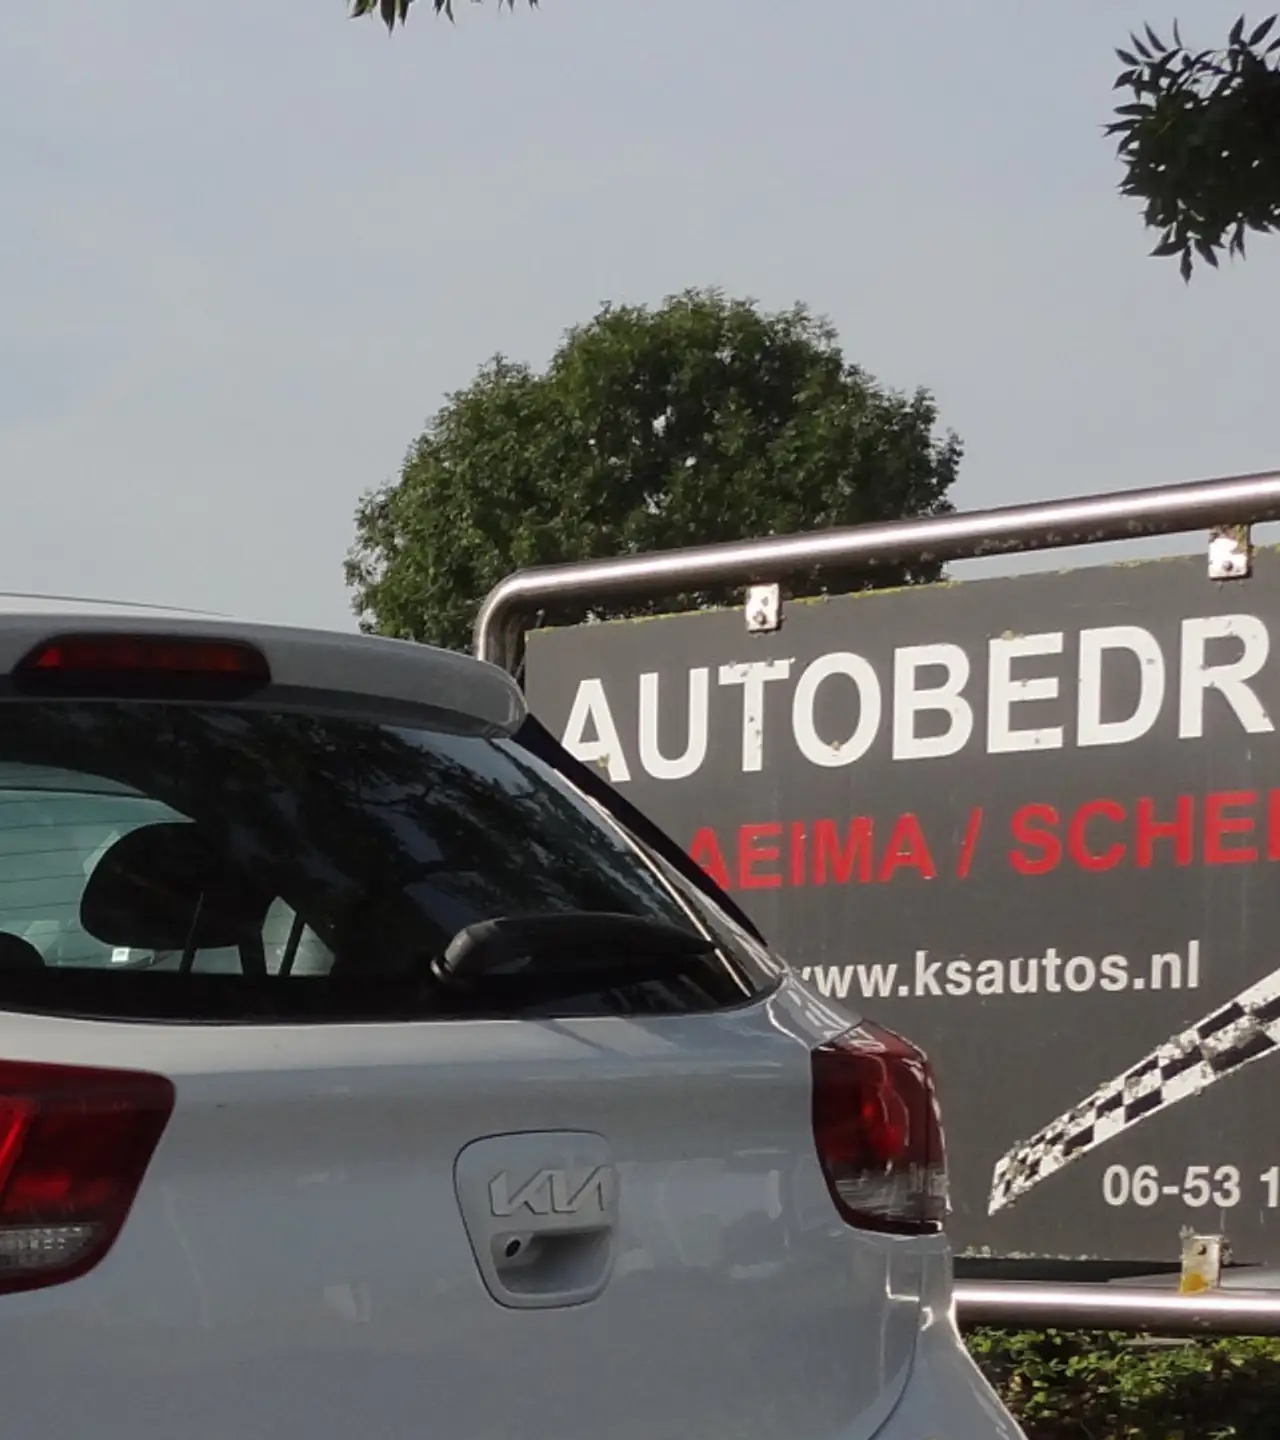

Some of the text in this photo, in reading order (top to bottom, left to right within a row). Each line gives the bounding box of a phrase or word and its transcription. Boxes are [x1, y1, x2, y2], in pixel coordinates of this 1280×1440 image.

[560, 613, 1276, 782] AUTOBEDR
[956, 807, 983, 878] /
[801, 940, 1201, 1000] ww.ksautos.nl
[487, 1164, 615, 1218] KIA
[1102, 1163, 1242, 1208] 06-53
